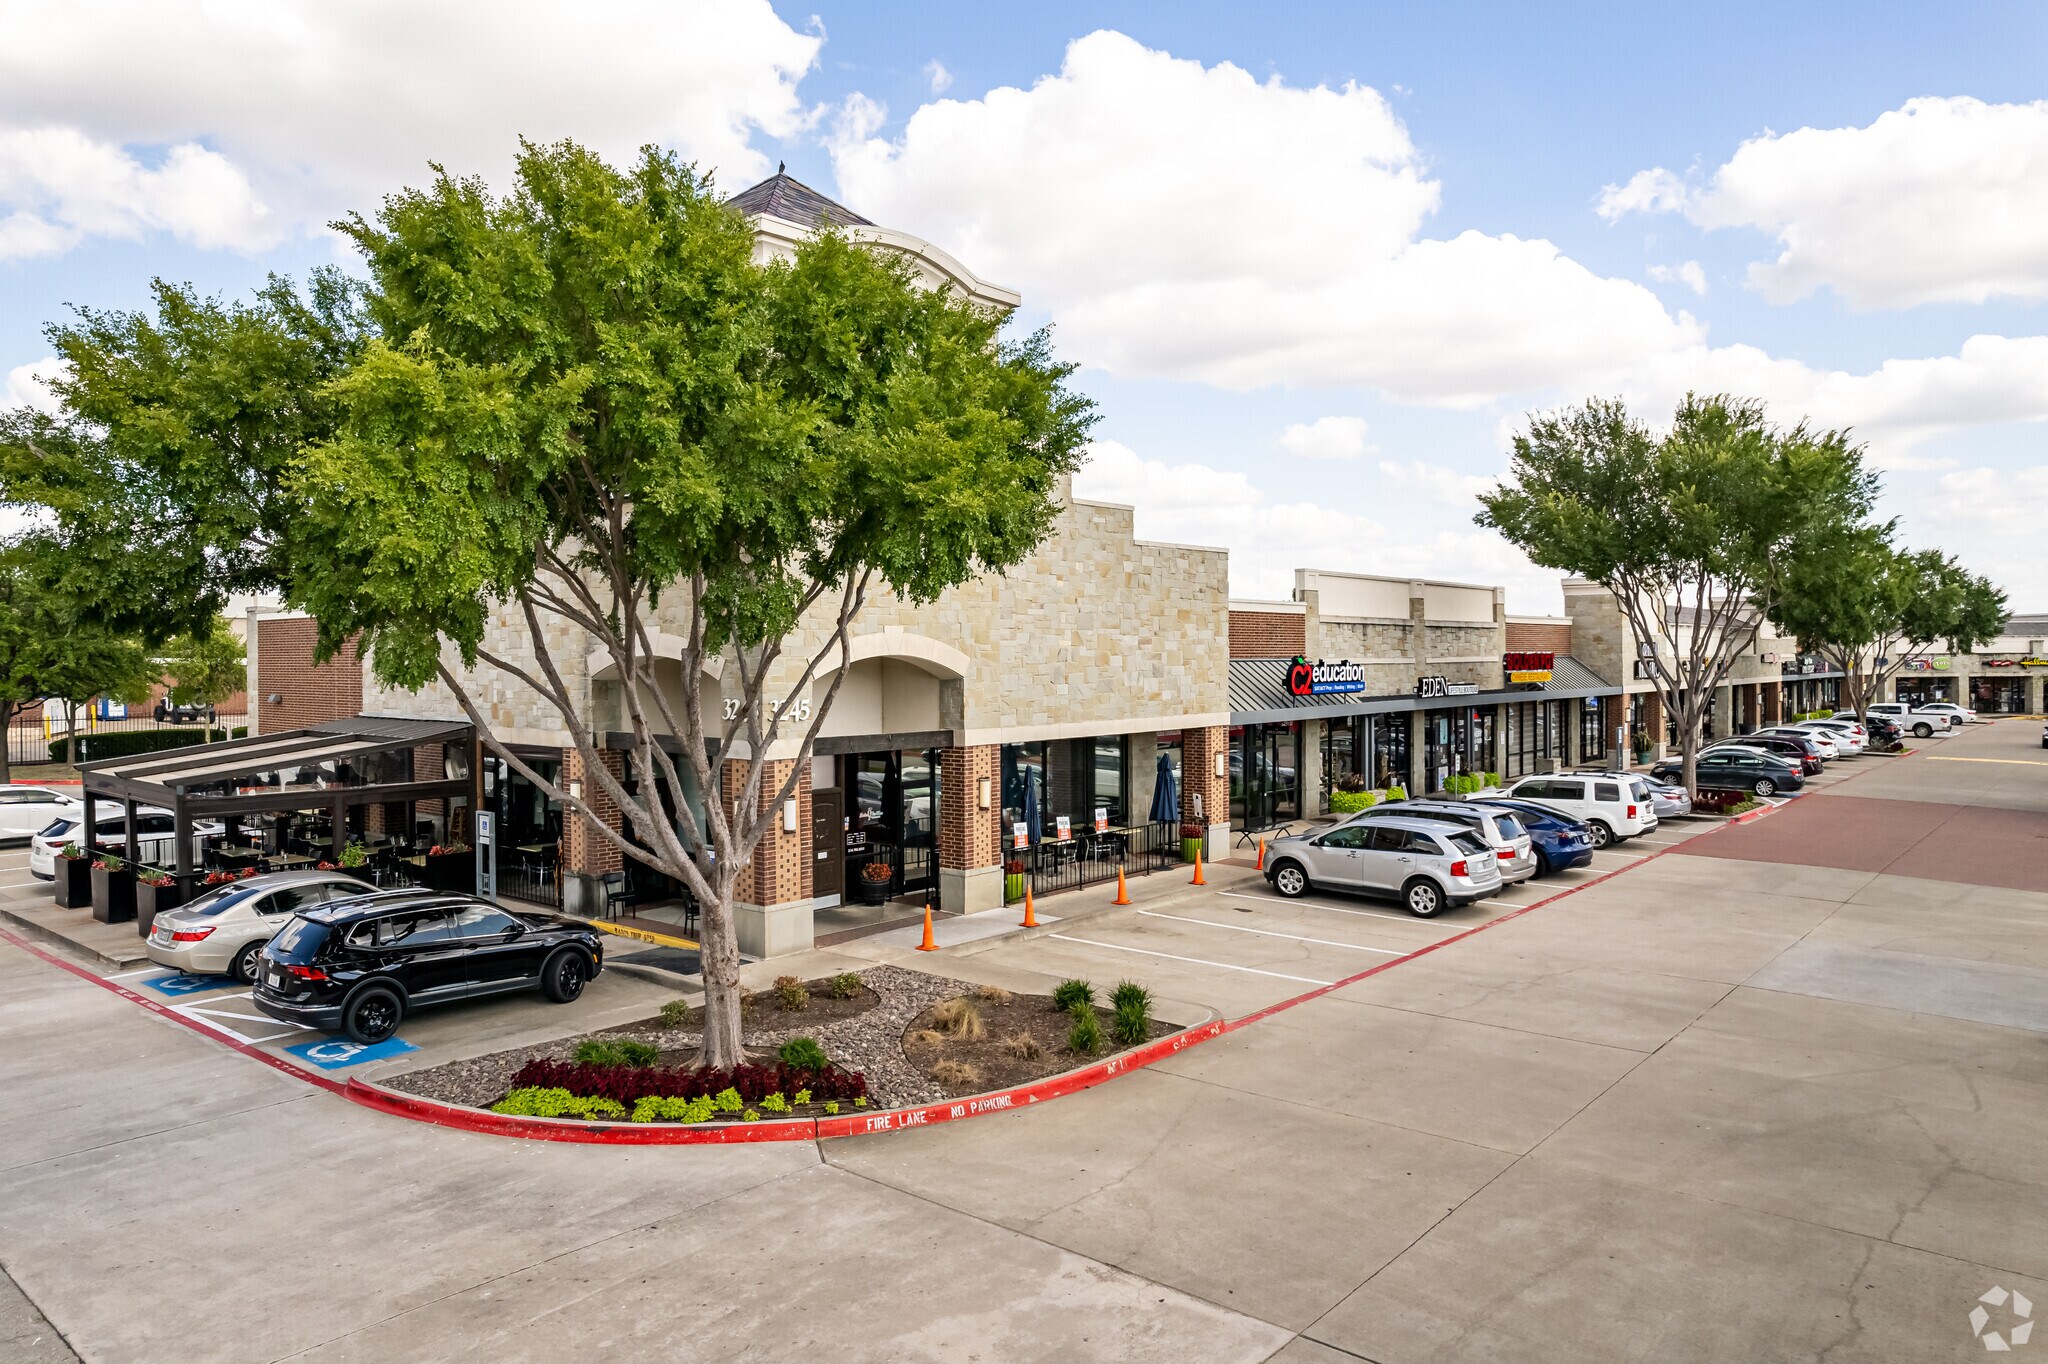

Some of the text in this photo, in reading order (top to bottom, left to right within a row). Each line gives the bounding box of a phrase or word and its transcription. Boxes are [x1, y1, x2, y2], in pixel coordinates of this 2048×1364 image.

[1312, 662, 1365, 683] education
[1422, 677, 1448, 698] EDEN
[866, 1095, 1012, 1131] FIRE LANE NO PARKING
